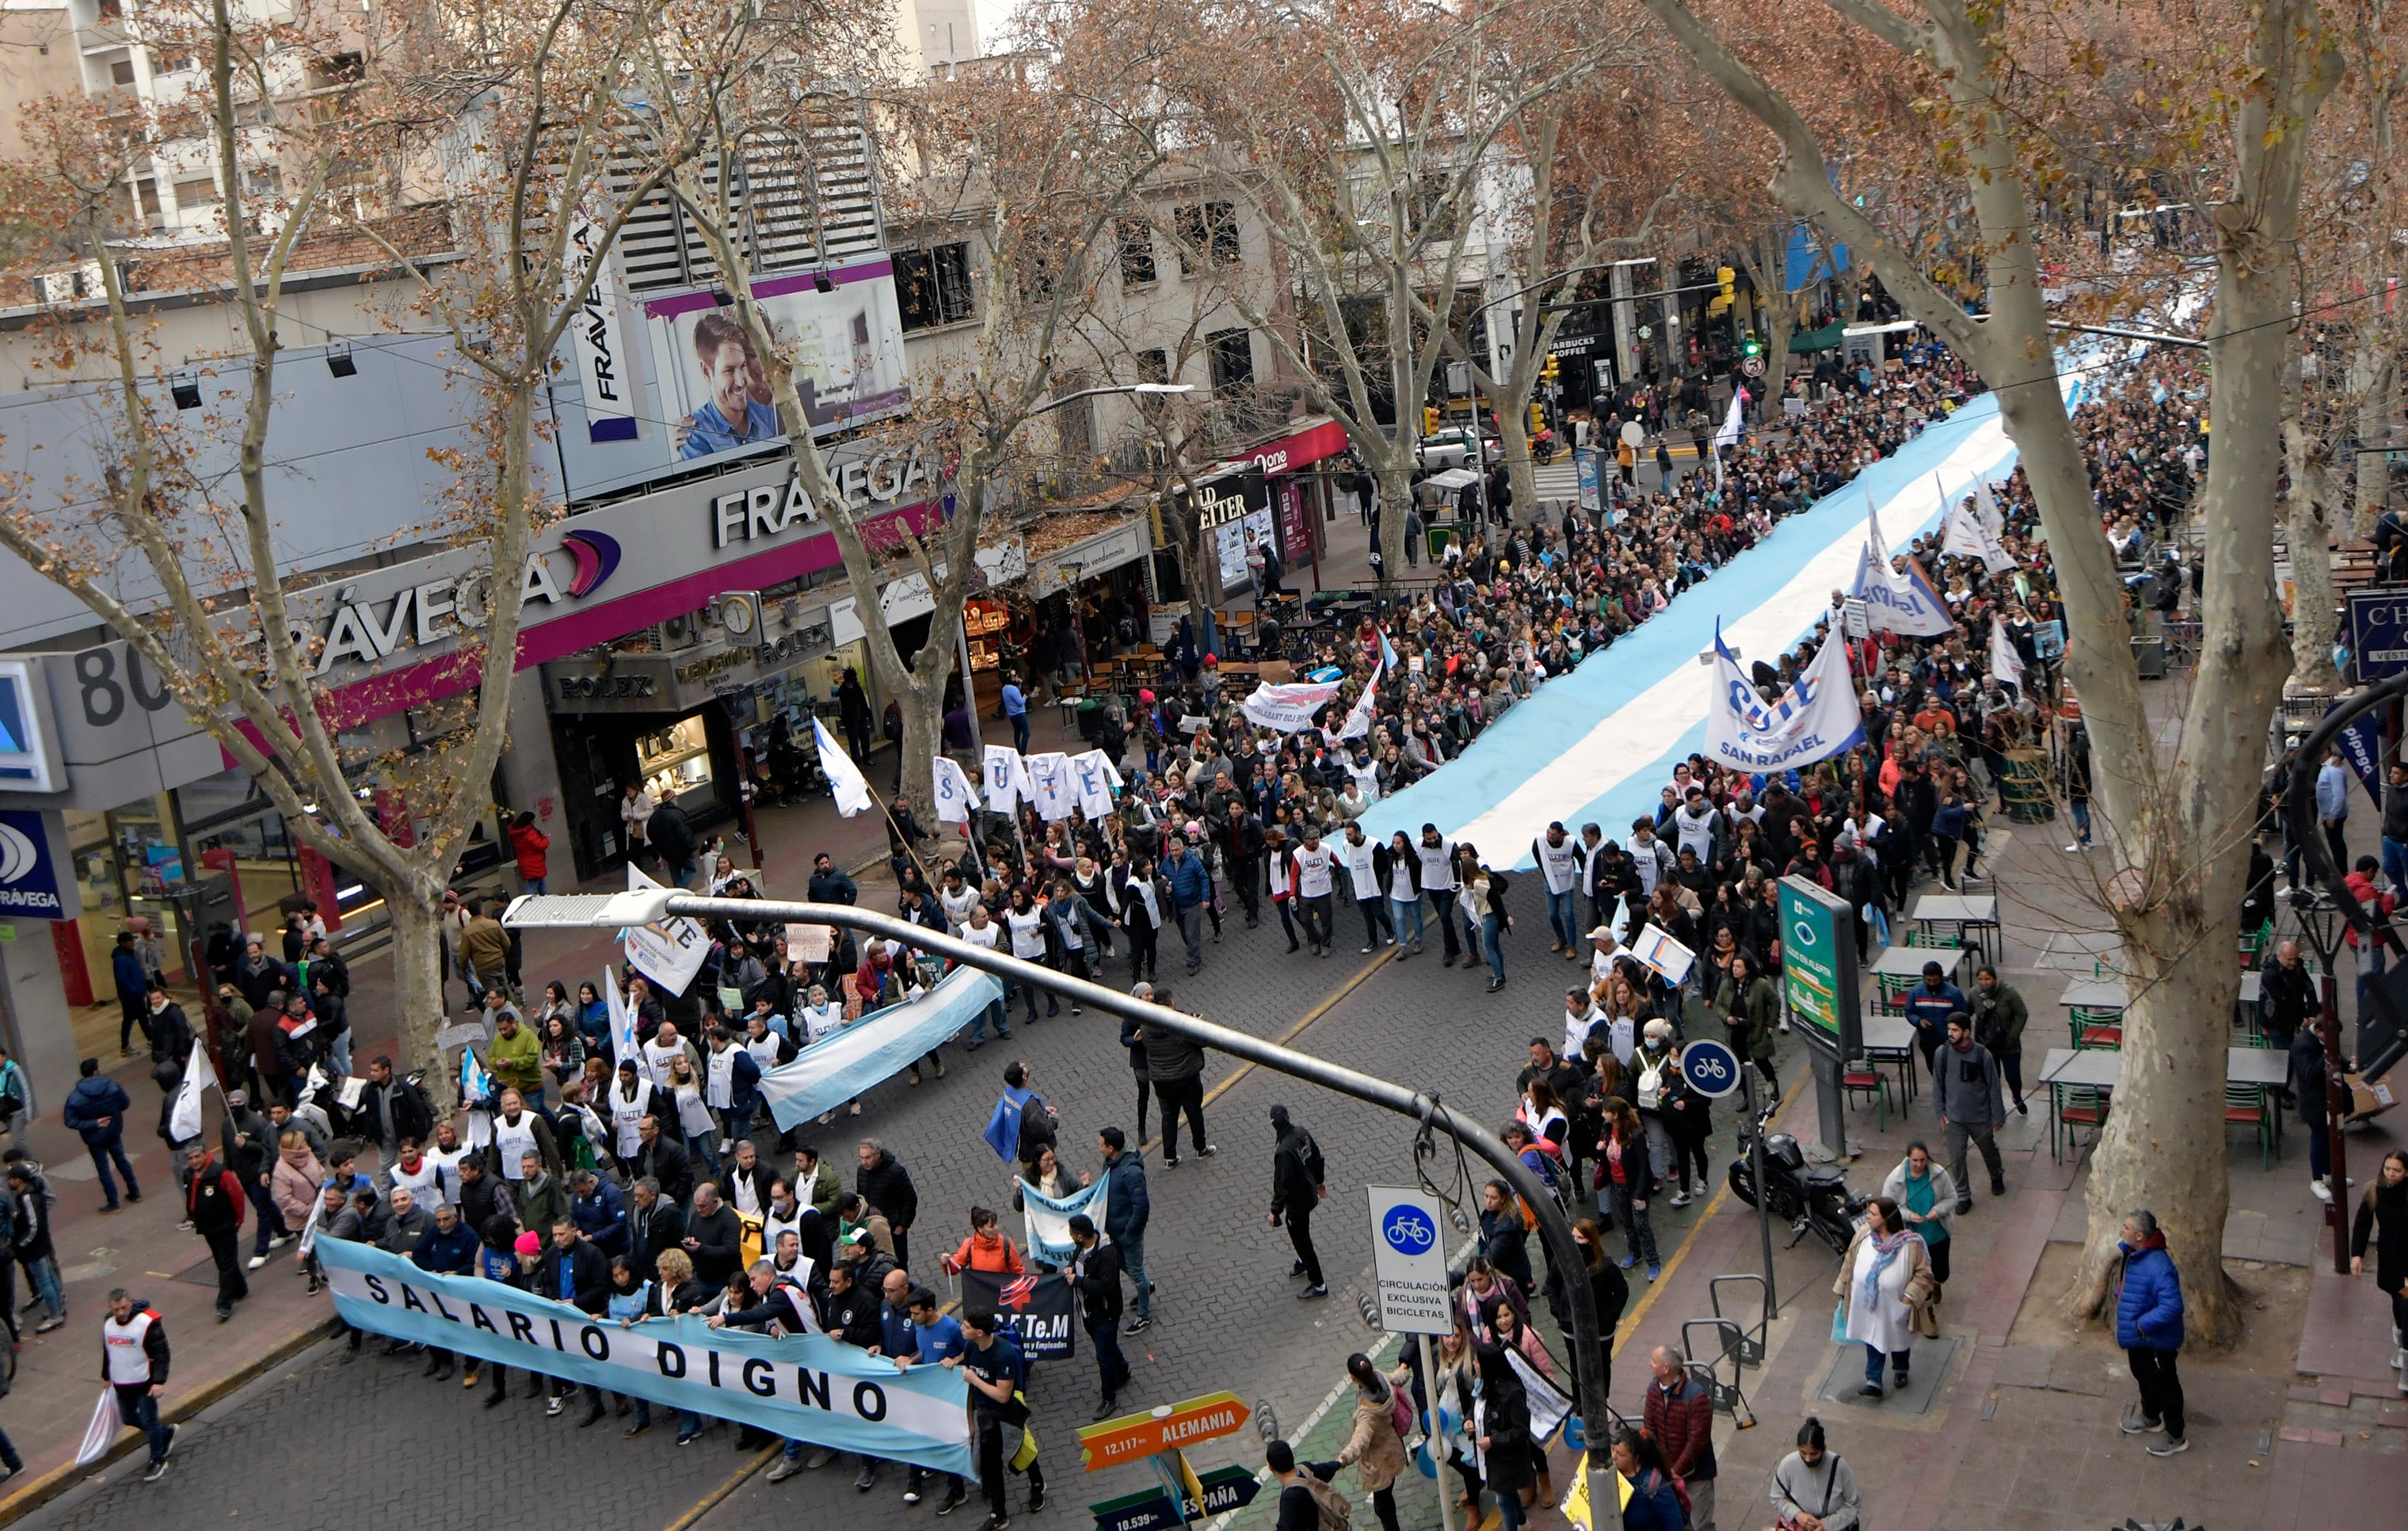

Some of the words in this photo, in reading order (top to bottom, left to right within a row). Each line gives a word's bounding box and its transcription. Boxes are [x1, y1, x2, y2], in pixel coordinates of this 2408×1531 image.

[1549, 337, 1595, 350] TARBUCKS
[757, 621, 831, 666] ROLEX
[558, 675, 653, 698] ROLEX
[1720, 741, 1752, 764] SAN
[1757, 733, 1825, 766] RAFAEL
[1681, 821, 1699, 831] SUTE
[1305, 856, 1324, 868] SUTE
[1548, 853, 1568, 862] SUTE
[620, 1109, 643, 1120] SUTE
[1379, 1279, 1447, 1292] CIRCULACIÓN
[1387, 1293, 1442, 1305] EXCLUSIVA
[1387, 1307, 1444, 1319] BICICLETAS
[364, 1272, 611, 1362] SALARIO
[657, 1342, 888, 1423] DIGNO
[1035, 1341, 1067, 1350] Empleados
[1104, 1437, 1137, 1456] 12.117
[1162, 1410, 1236, 1444] ALEMANIA
[1116, 1513, 1151, 1531] 10.539
